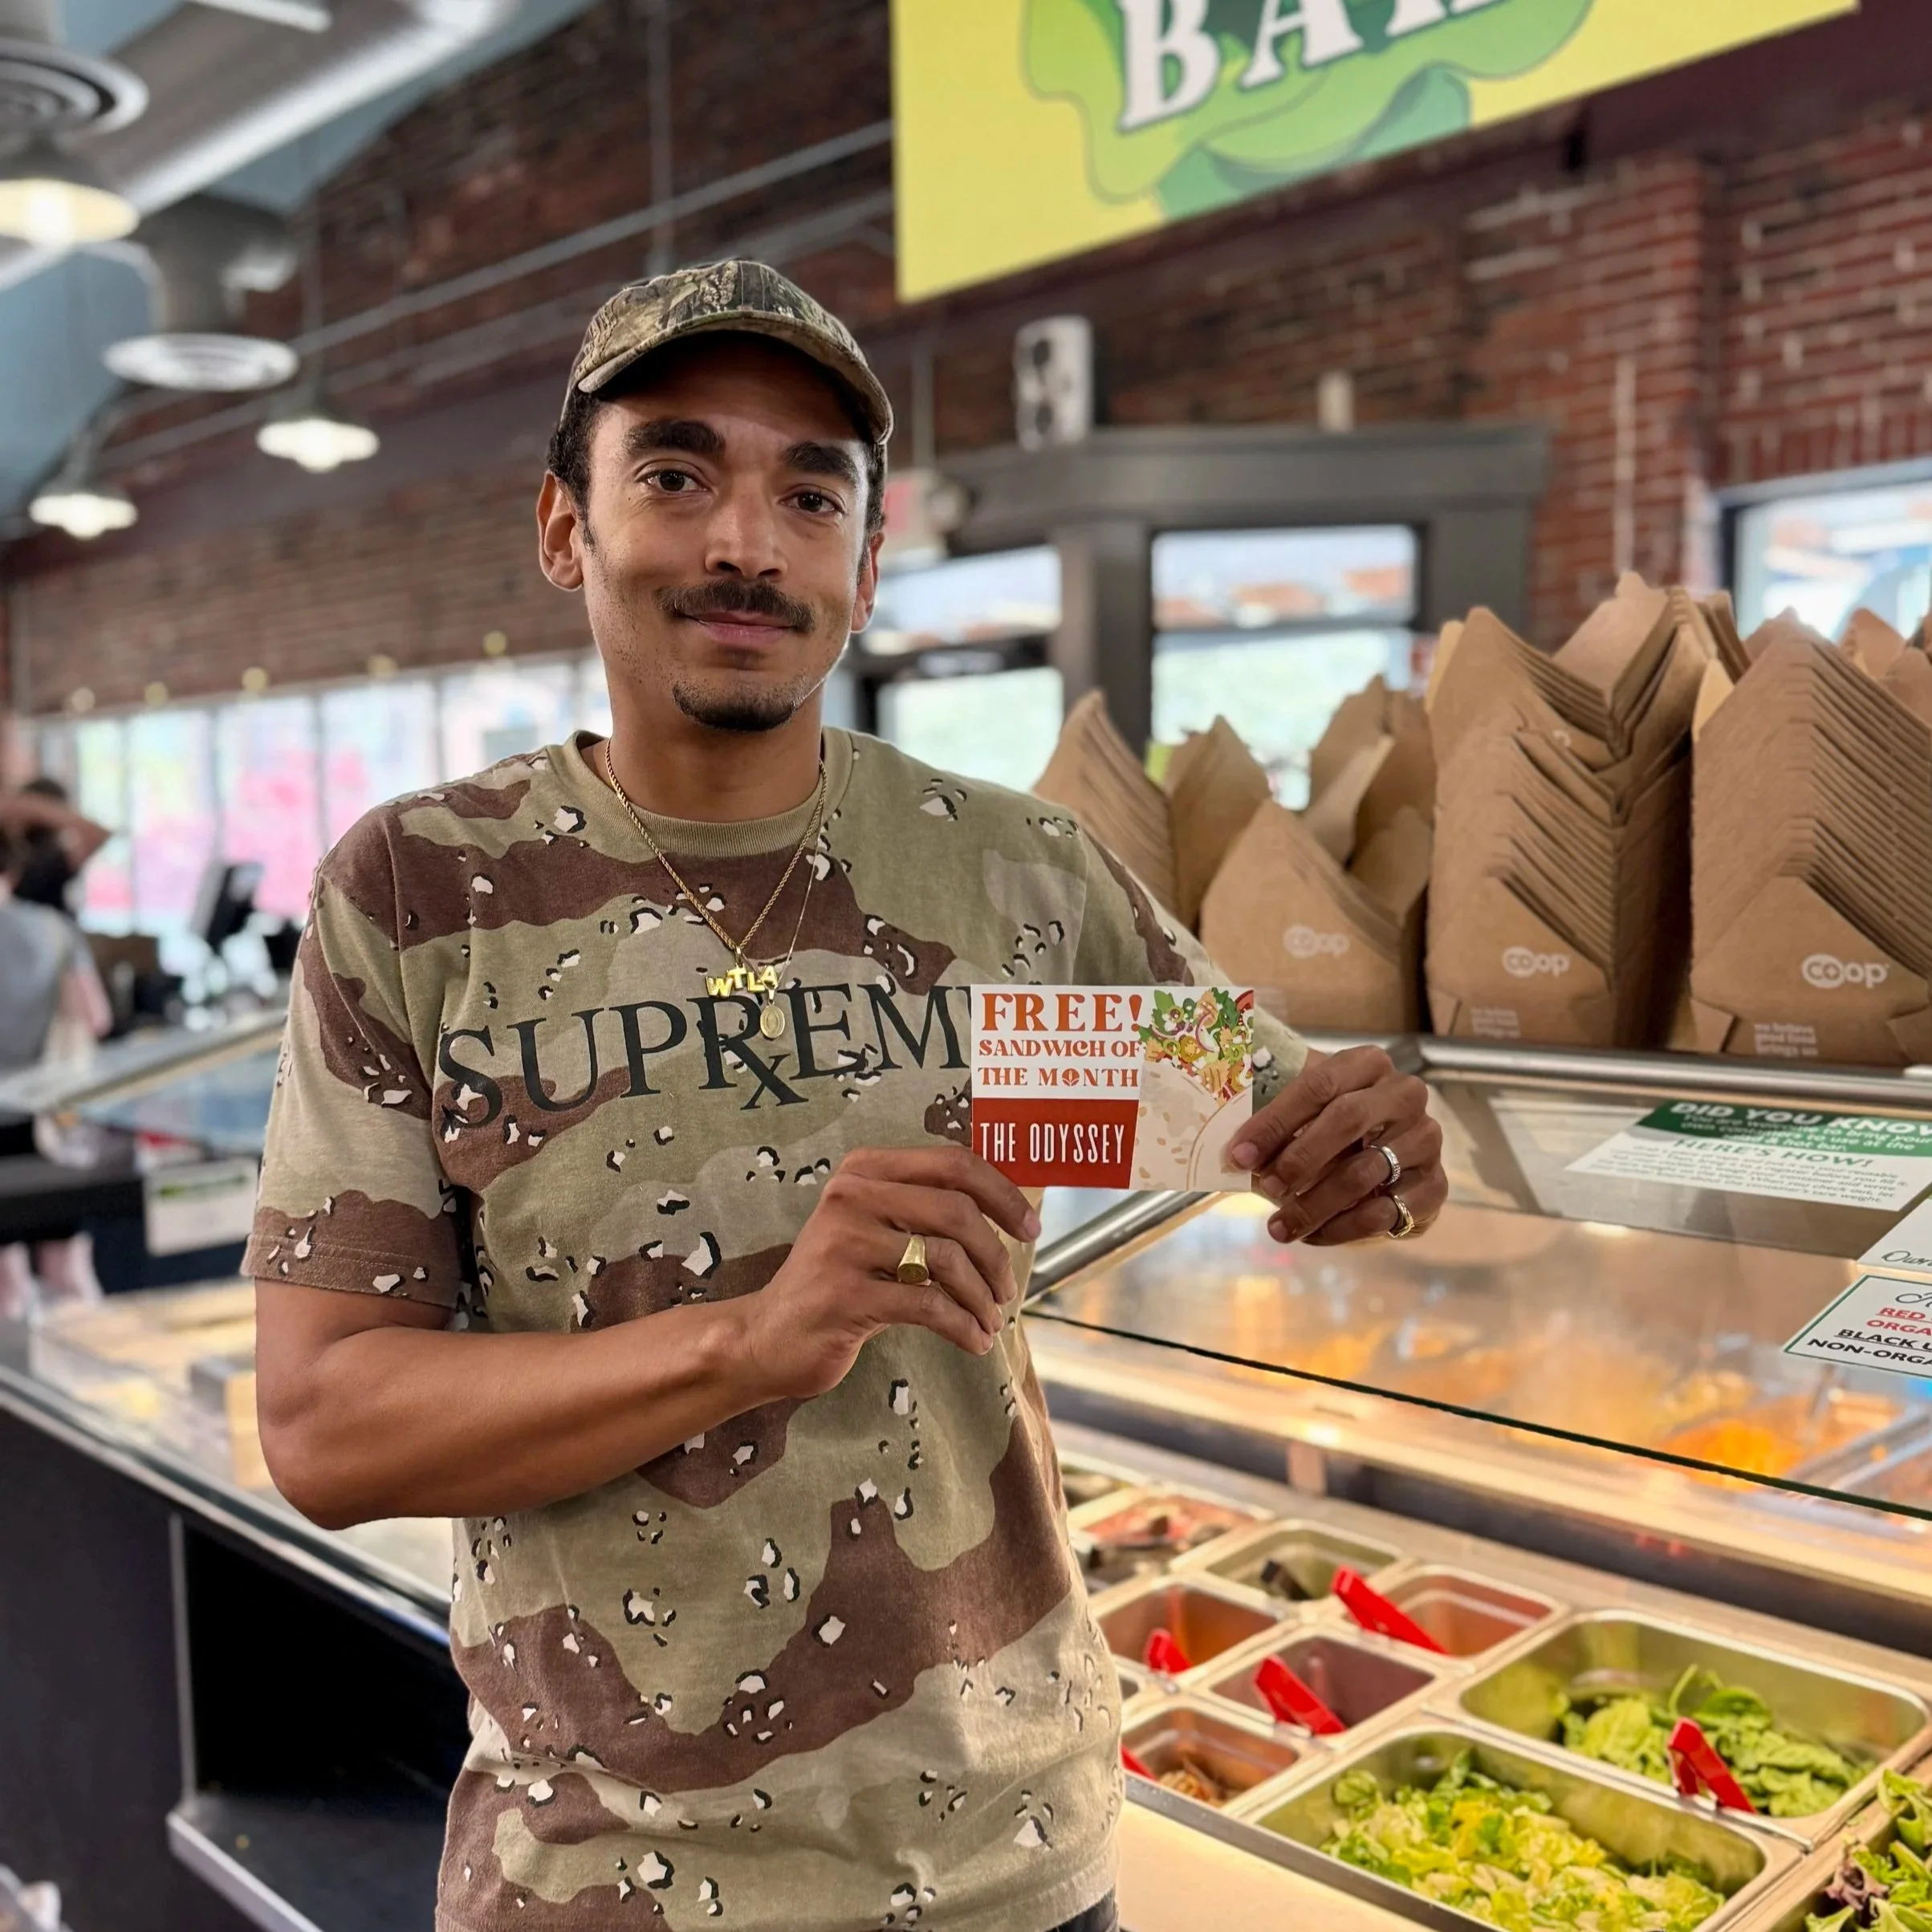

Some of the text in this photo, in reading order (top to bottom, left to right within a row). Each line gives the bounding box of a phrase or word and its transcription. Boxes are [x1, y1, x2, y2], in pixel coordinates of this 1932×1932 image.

[1114, 0, 1507, 135] BA
[706, 965, 779, 998] WTLA
[982, 993, 1143, 1032] FREE!
[978, 1039, 1143, 1057] SANDWICH OF
[978, 1068, 1139, 1087] THE MONTH
[1670, 1102, 1735, 1117] DID
[1746, 1108, 1824, 1125] YOU
[980, 1123, 1125, 1164] THE ODYSSEY
[1783, 1137, 1814, 1147] hot
[1806, 1133, 1827, 1141] to
[1829, 1137, 1860, 1146] use
[1863, 1140, 1883, 1148] at
[1885, 1141, 1916, 1151] the
[1823, 1126, 1844, 1137] to
[1845, 1129, 1891, 1142] bring
[1674, 1139, 1775, 1157] HERE'S
[1780, 1151, 1874, 1168] HOW!
[1879, 1308, 1926, 1320] RED
[1867, 1320, 1932, 1336] ORGA
[1842, 1329, 1918, 1348] BLACK
